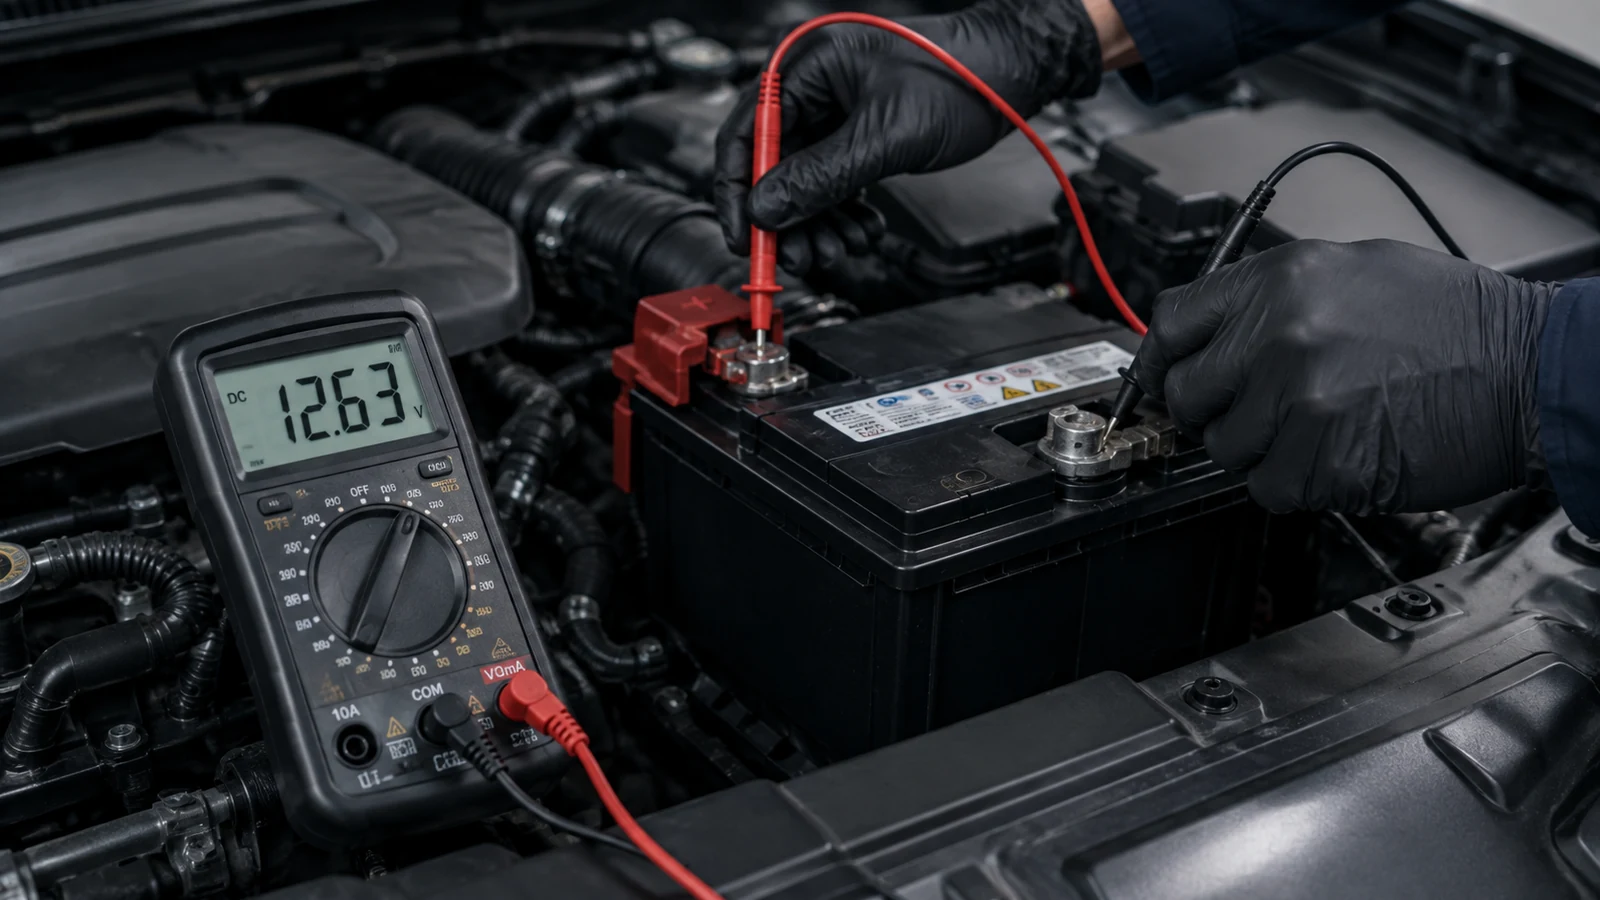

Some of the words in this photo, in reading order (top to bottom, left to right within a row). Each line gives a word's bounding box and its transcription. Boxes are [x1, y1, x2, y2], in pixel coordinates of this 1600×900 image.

[227, 391, 247, 405] DC
[279, 361, 405, 443] 12.63
[414, 405, 423, 418] V
[350, 485, 369, 497] OFF
[411, 683, 444, 701] COM
[332, 704, 361, 721] 10A
